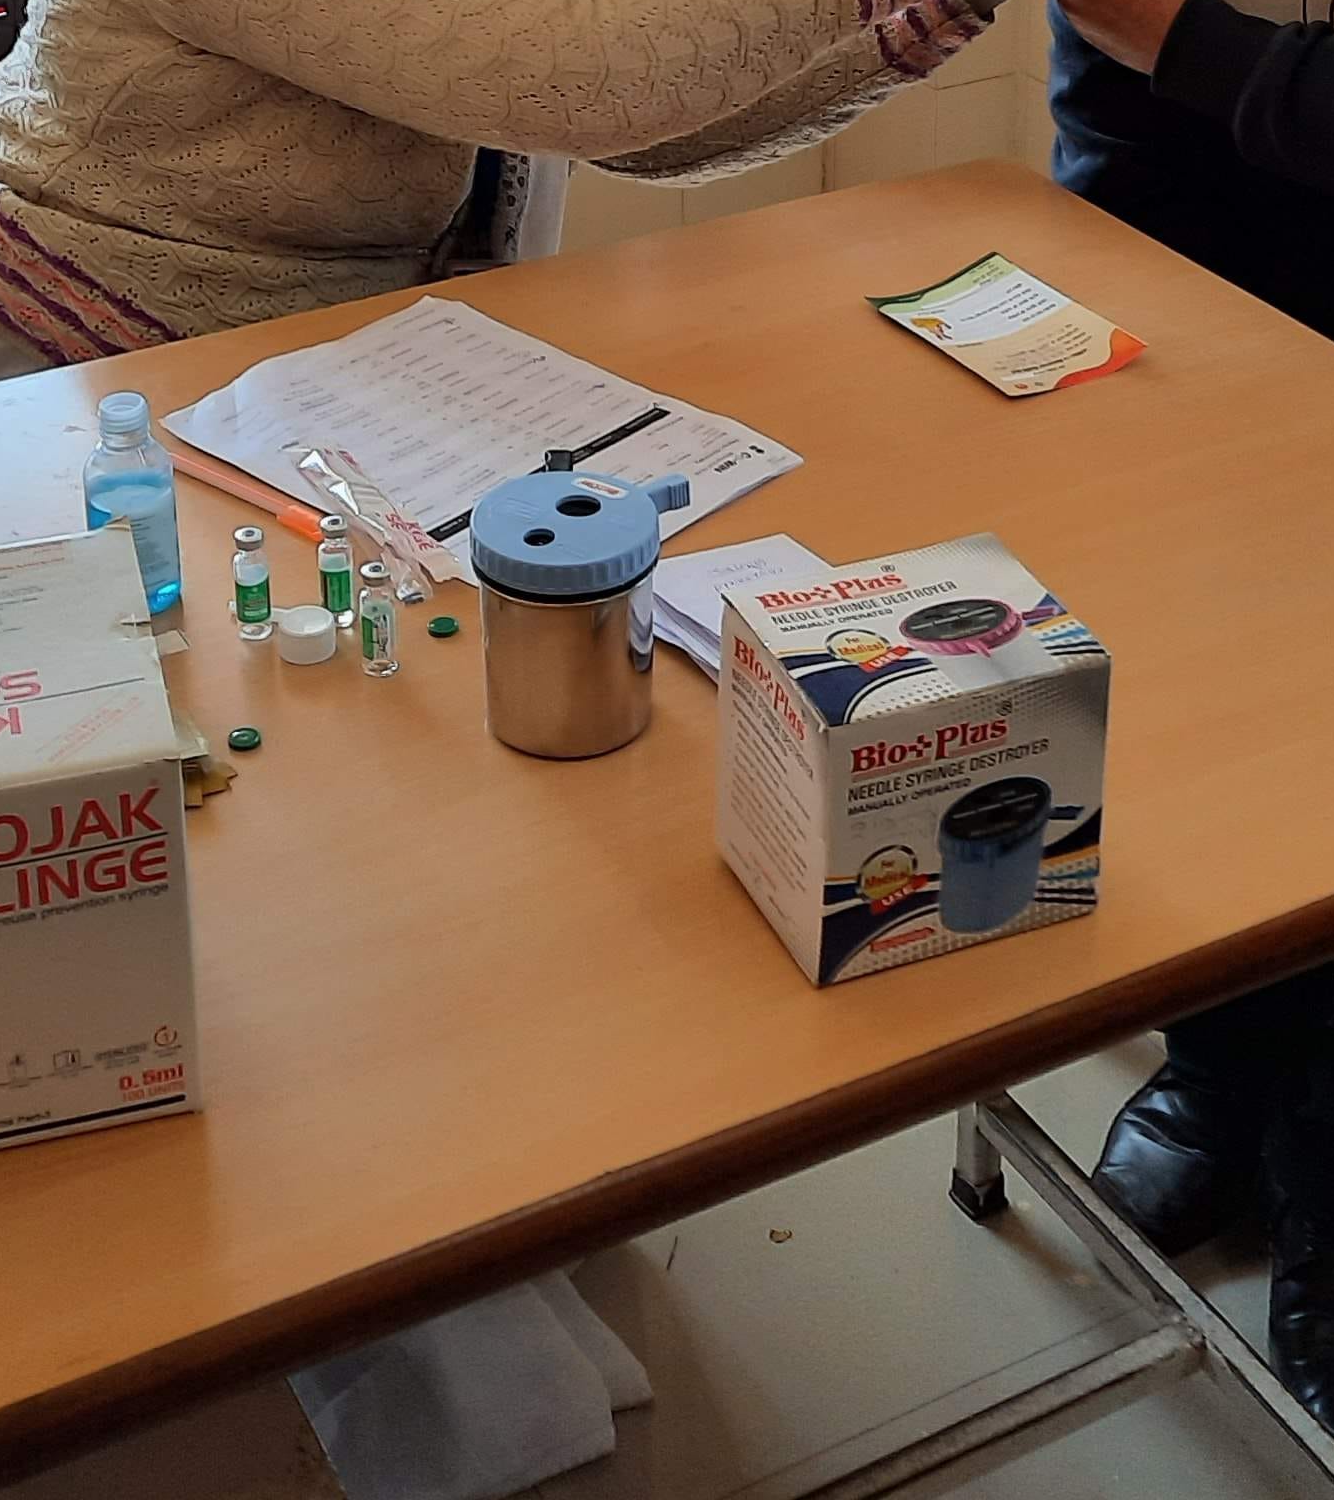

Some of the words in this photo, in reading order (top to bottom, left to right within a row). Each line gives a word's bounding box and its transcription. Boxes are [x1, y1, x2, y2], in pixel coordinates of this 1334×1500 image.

[771, 609, 820, 626] NEEDLE
[826, 598, 878, 618] SYRINGE
[883, 581, 958, 606] DESTROYER
[779, 618, 835, 633] MANUALLY
[838, 608, 893, 623] OPERATED
[848, 776, 901, 802] NEEDLE
[906, 760, 965, 788] SYRINGE
[970, 738, 1050, 771] DESTROYER
[848, 794, 908, 816] MANUALLY
[911, 778, 971, 800] OPERATED
